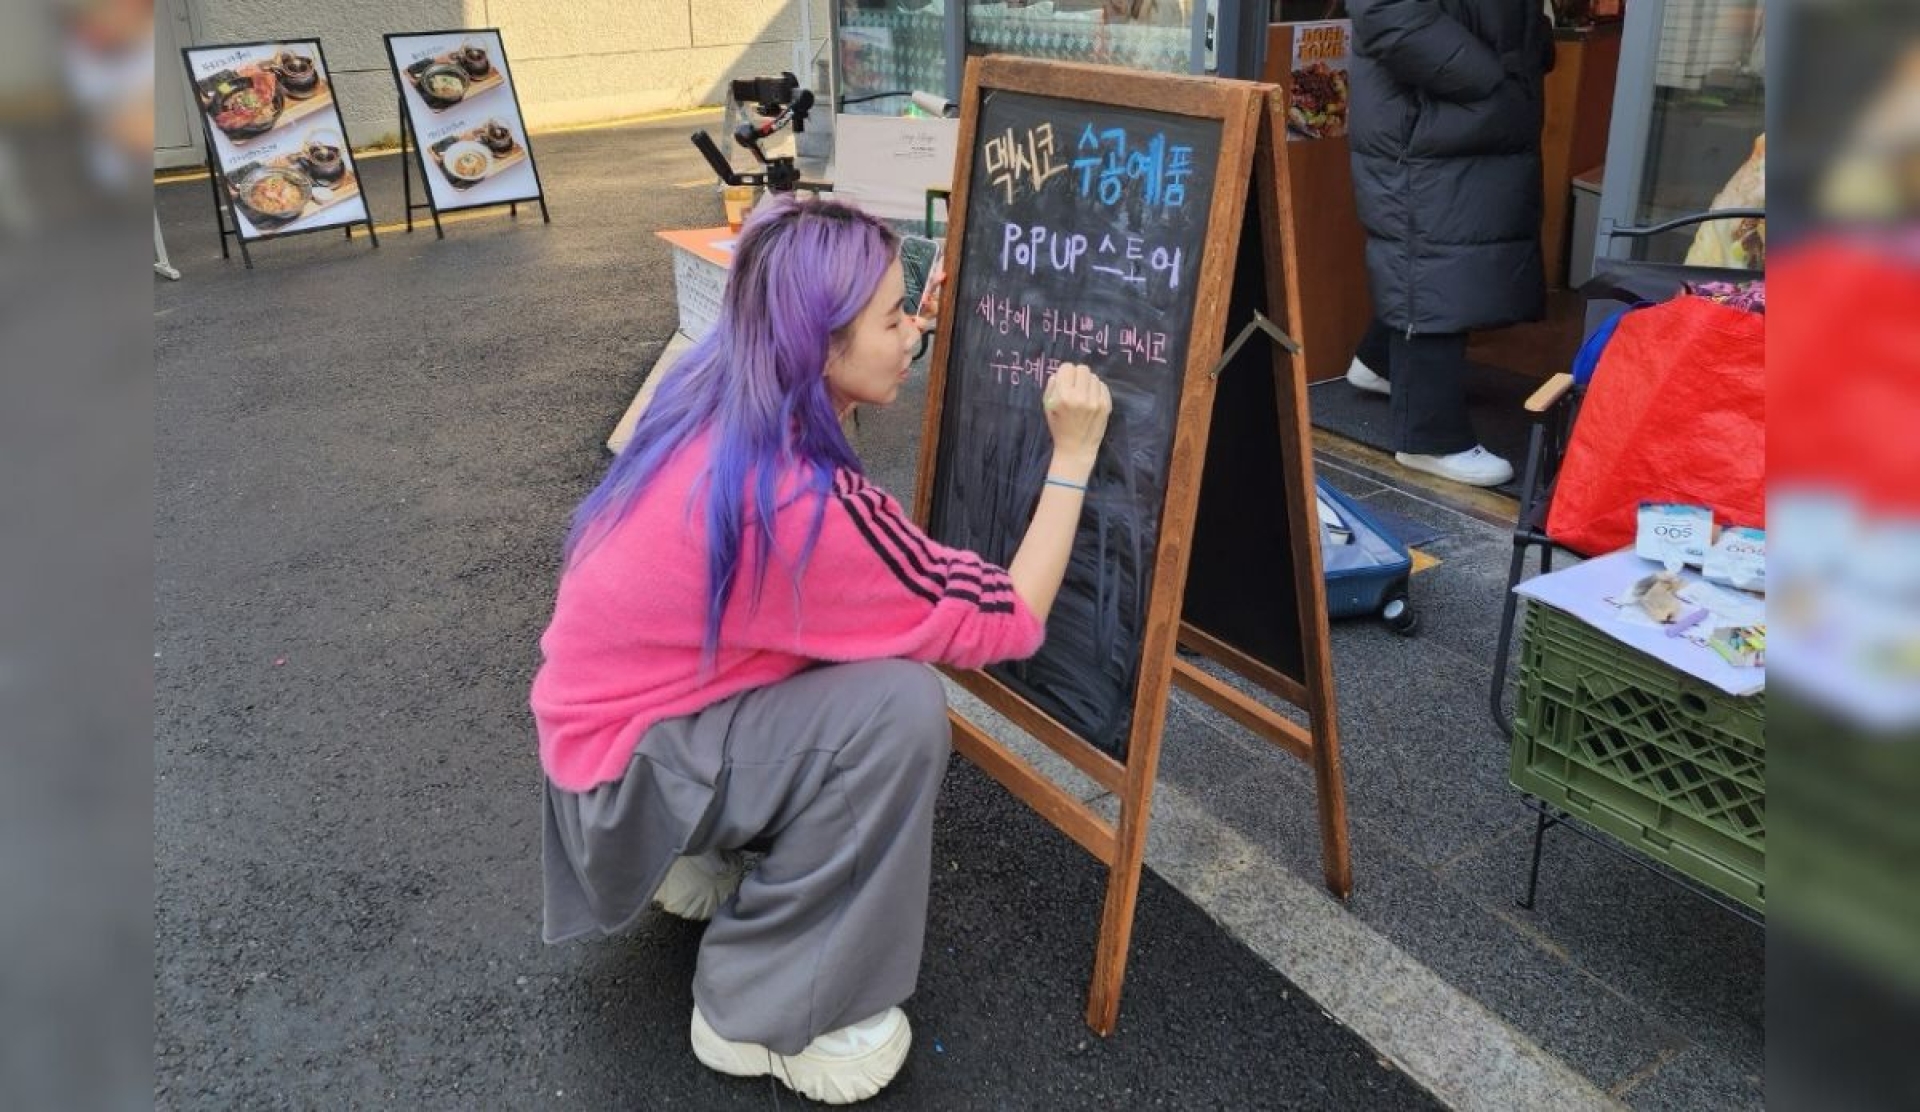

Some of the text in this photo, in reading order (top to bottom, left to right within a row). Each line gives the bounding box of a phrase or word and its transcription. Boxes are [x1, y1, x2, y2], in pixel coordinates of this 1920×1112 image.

[985, 122, 1193, 206] 멕시코 수공예품
[1051, 233, 1087, 275] UP
[1092, 234, 1182, 289] 스토어
[976, 294, 1168, 366] 세상에 하나뿐인 멕시코
